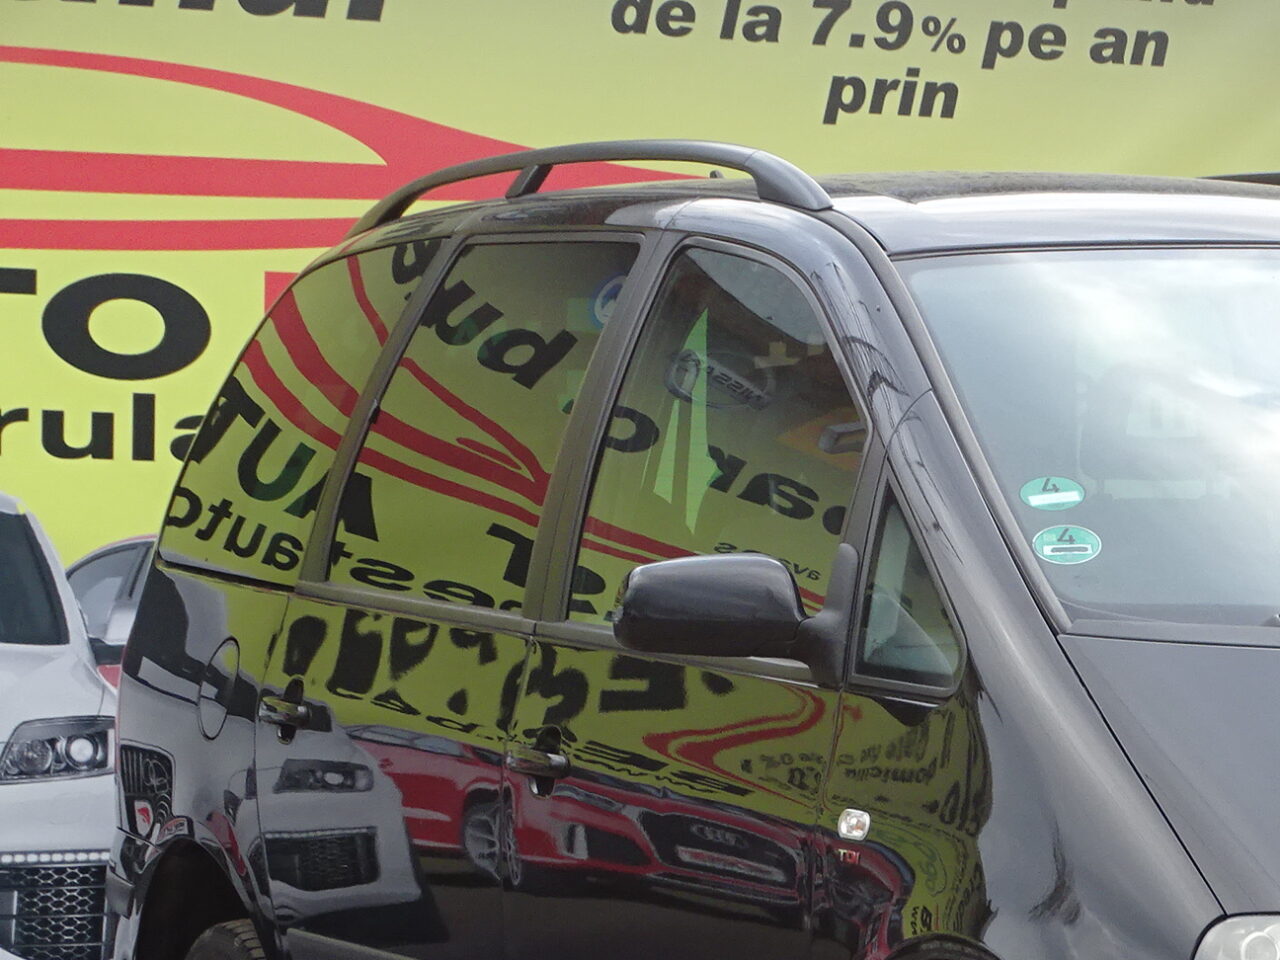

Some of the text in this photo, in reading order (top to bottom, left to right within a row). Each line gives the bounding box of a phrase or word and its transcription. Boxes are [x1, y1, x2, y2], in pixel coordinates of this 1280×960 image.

[611, 0, 697, 38] de
[719, 0, 783, 43] la
[981, 20, 1068, 70] pe
[1089, 27, 1169, 67] an
[822, 67, 960, 125] prin
[1057, 527, 1076, 543] 4
